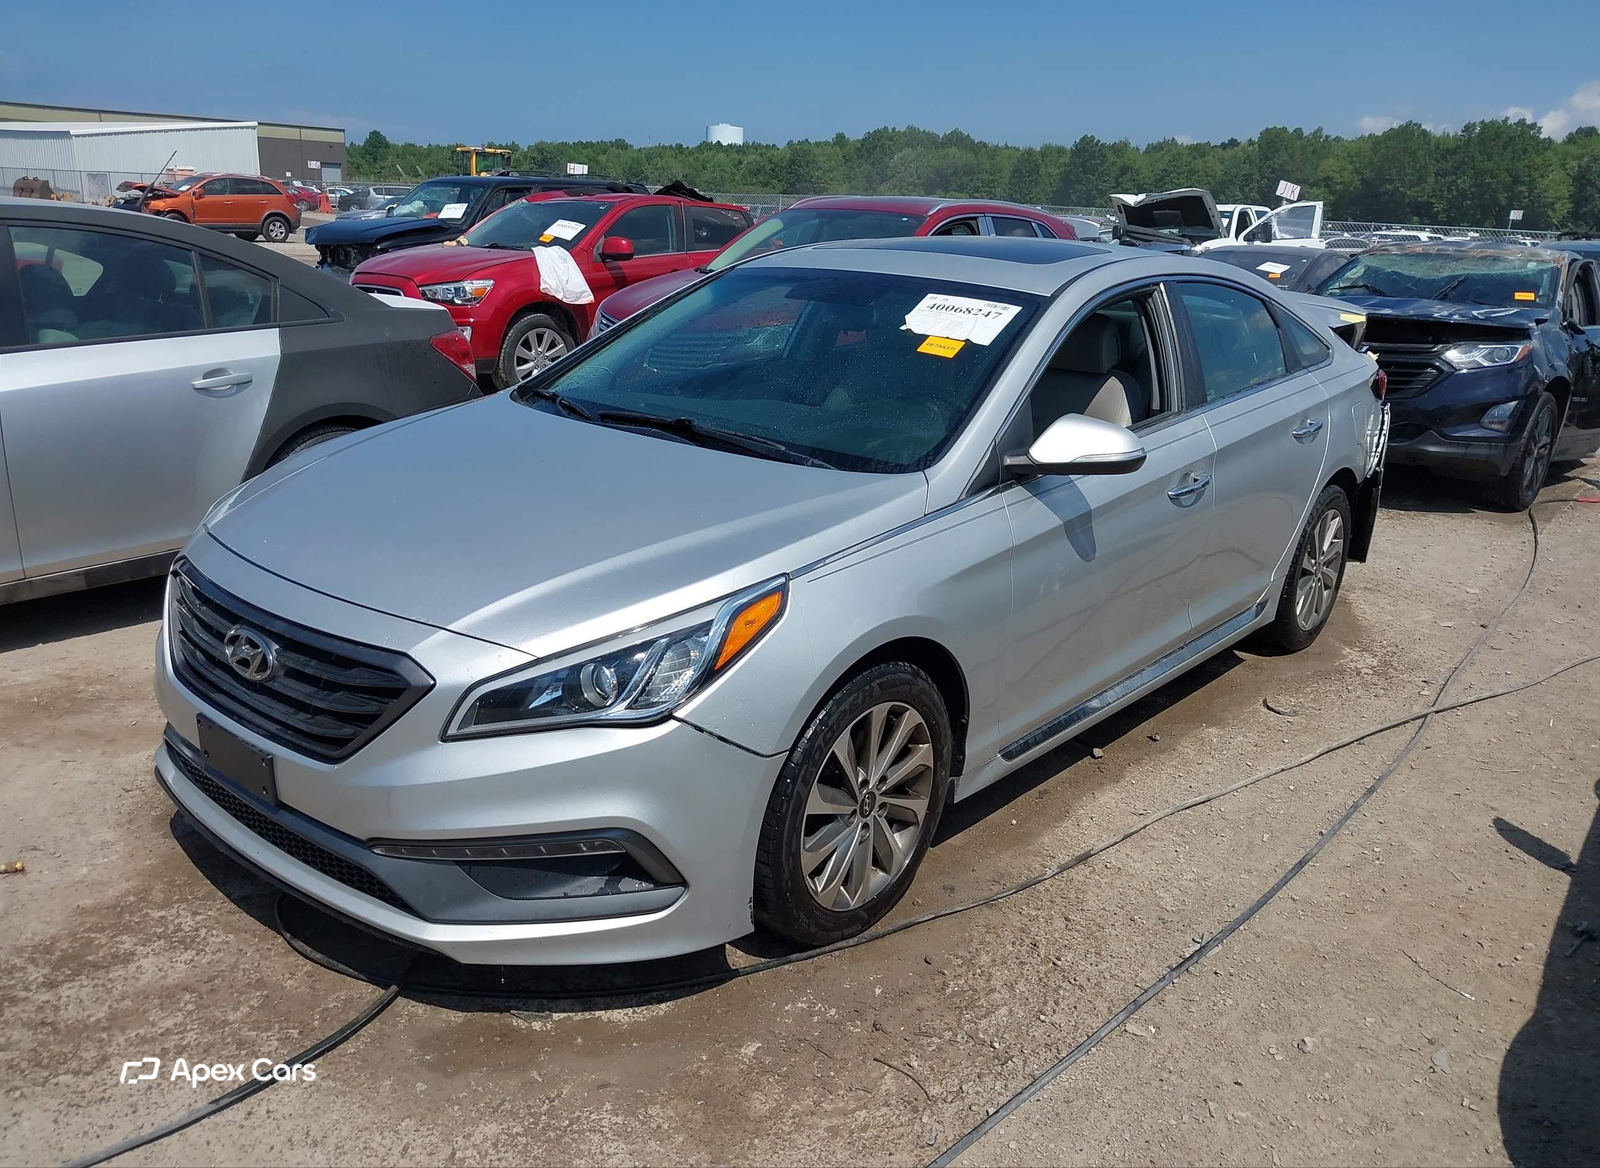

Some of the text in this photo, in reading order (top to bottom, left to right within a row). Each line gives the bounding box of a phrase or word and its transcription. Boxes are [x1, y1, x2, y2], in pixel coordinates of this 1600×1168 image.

[926, 302, 1002, 320] 40068247
[926, 342, 956, 351] DETAILED
[800, 684, 875, 788] COOPER
